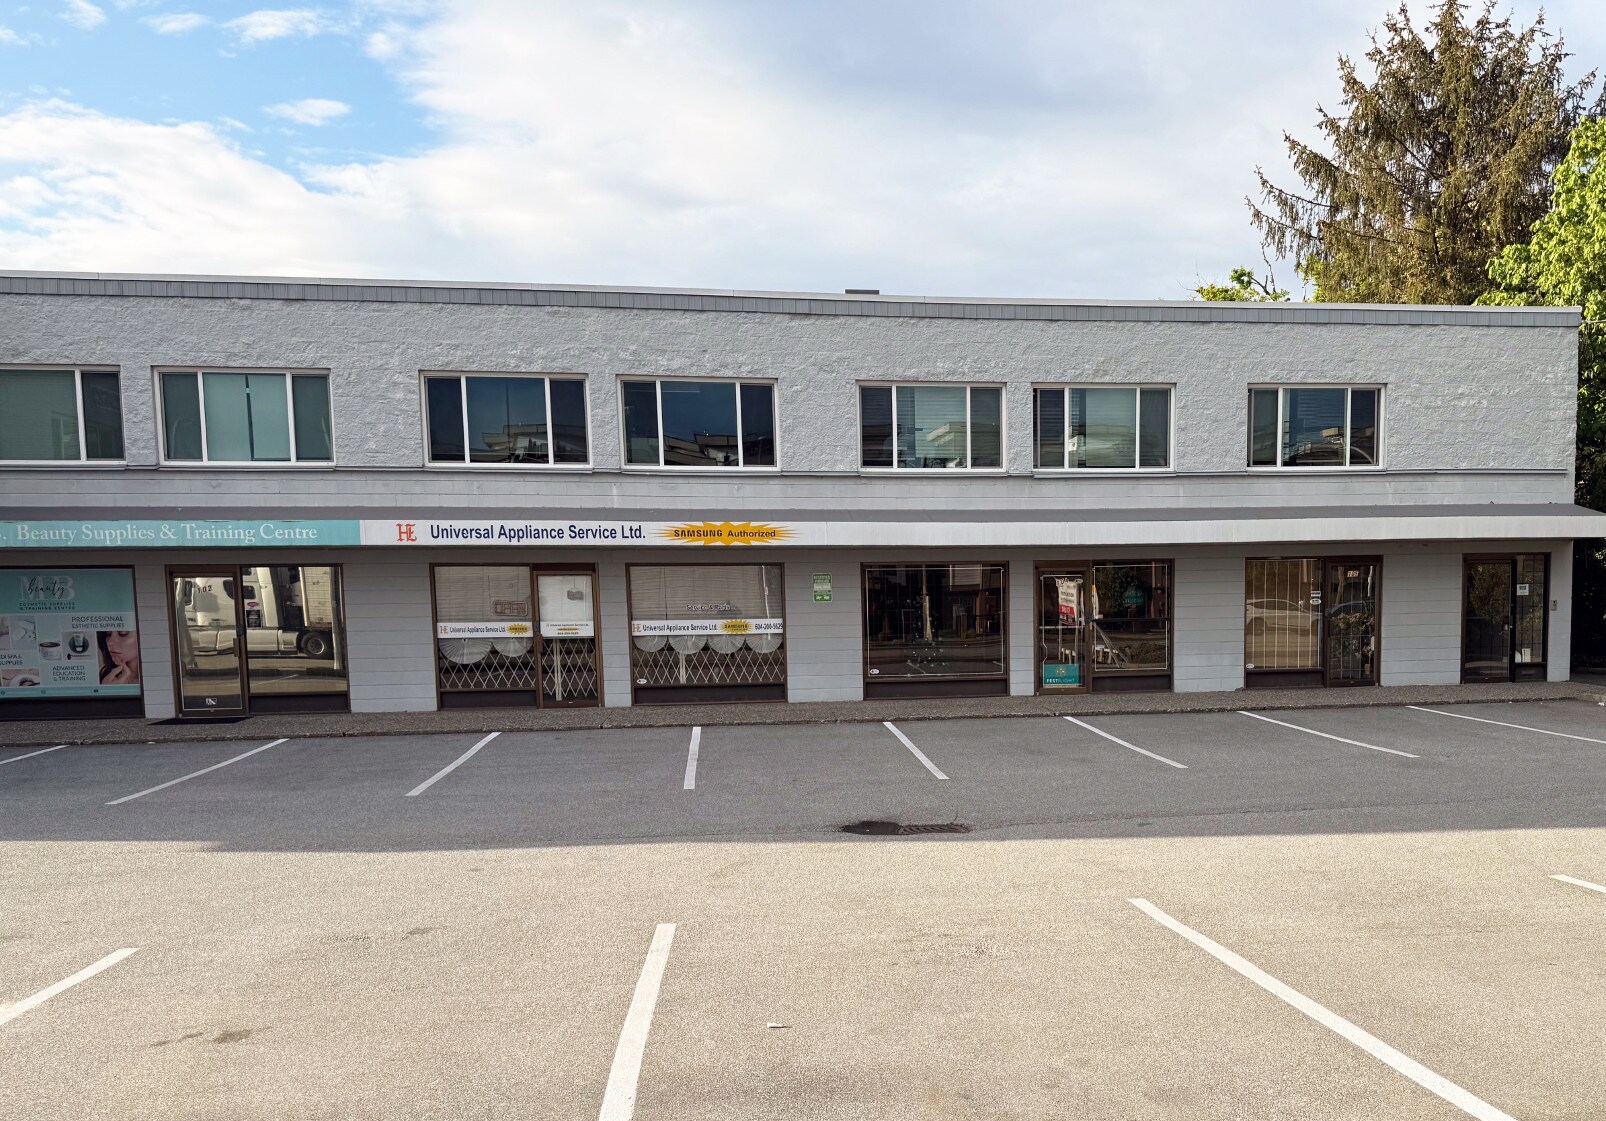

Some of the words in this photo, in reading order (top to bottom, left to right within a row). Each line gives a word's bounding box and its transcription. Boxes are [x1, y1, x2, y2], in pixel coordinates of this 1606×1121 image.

[16, 524, 77, 545] Beauty
[82, 524, 155, 545] Supplies
[159, 524, 179, 540] &
[181, 523, 255, 544] Training
[260, 523, 318, 540] Centre
[430, 524, 494, 540] Universal
[498, 524, 564, 543] Appliance
[568, 524, 617, 539] Service
[621, 525, 646, 539] Ltd.
[674, 529, 723, 538] SAMSUNG
[727, 529, 776, 538] Authorized
[28, 577, 66, 599] beauty
[197, 584, 213, 594] 102
[450, 625, 467, 633] Universal
[467, 626, 485, 634] Appliance
[485, 625, 498, 633] Service
[642, 624, 666, 632] Universal
[666, 624, 690, 633] Appliance
[690, 623, 708, 631] Service
[708, 623, 718, 631] Ltd.
